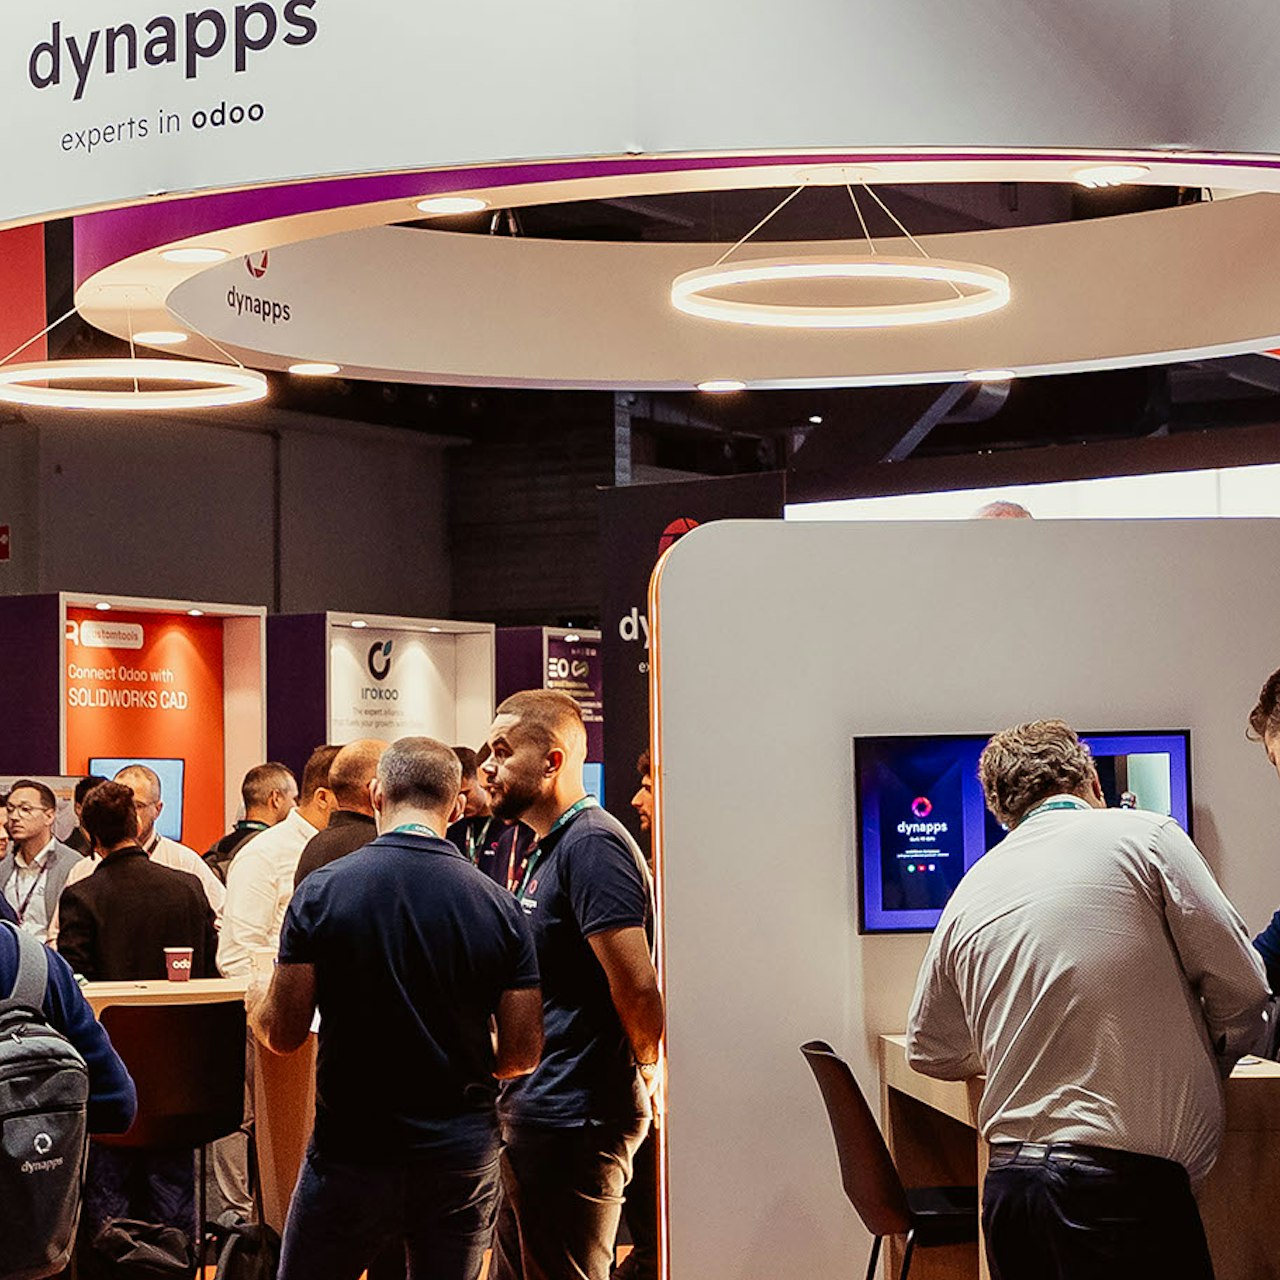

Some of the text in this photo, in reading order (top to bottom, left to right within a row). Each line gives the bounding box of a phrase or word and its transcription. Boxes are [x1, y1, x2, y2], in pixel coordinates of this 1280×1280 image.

[61, 102, 264, 153] experts in odoo
[227, 285, 291, 324] dynapps
[68, 664, 175, 683] Connect Odoo with
[68, 687, 188, 710] SOLIDWORKS CAD
[897, 821, 949, 836] dynapps
[20, 1156, 64, 1174] dynapps
